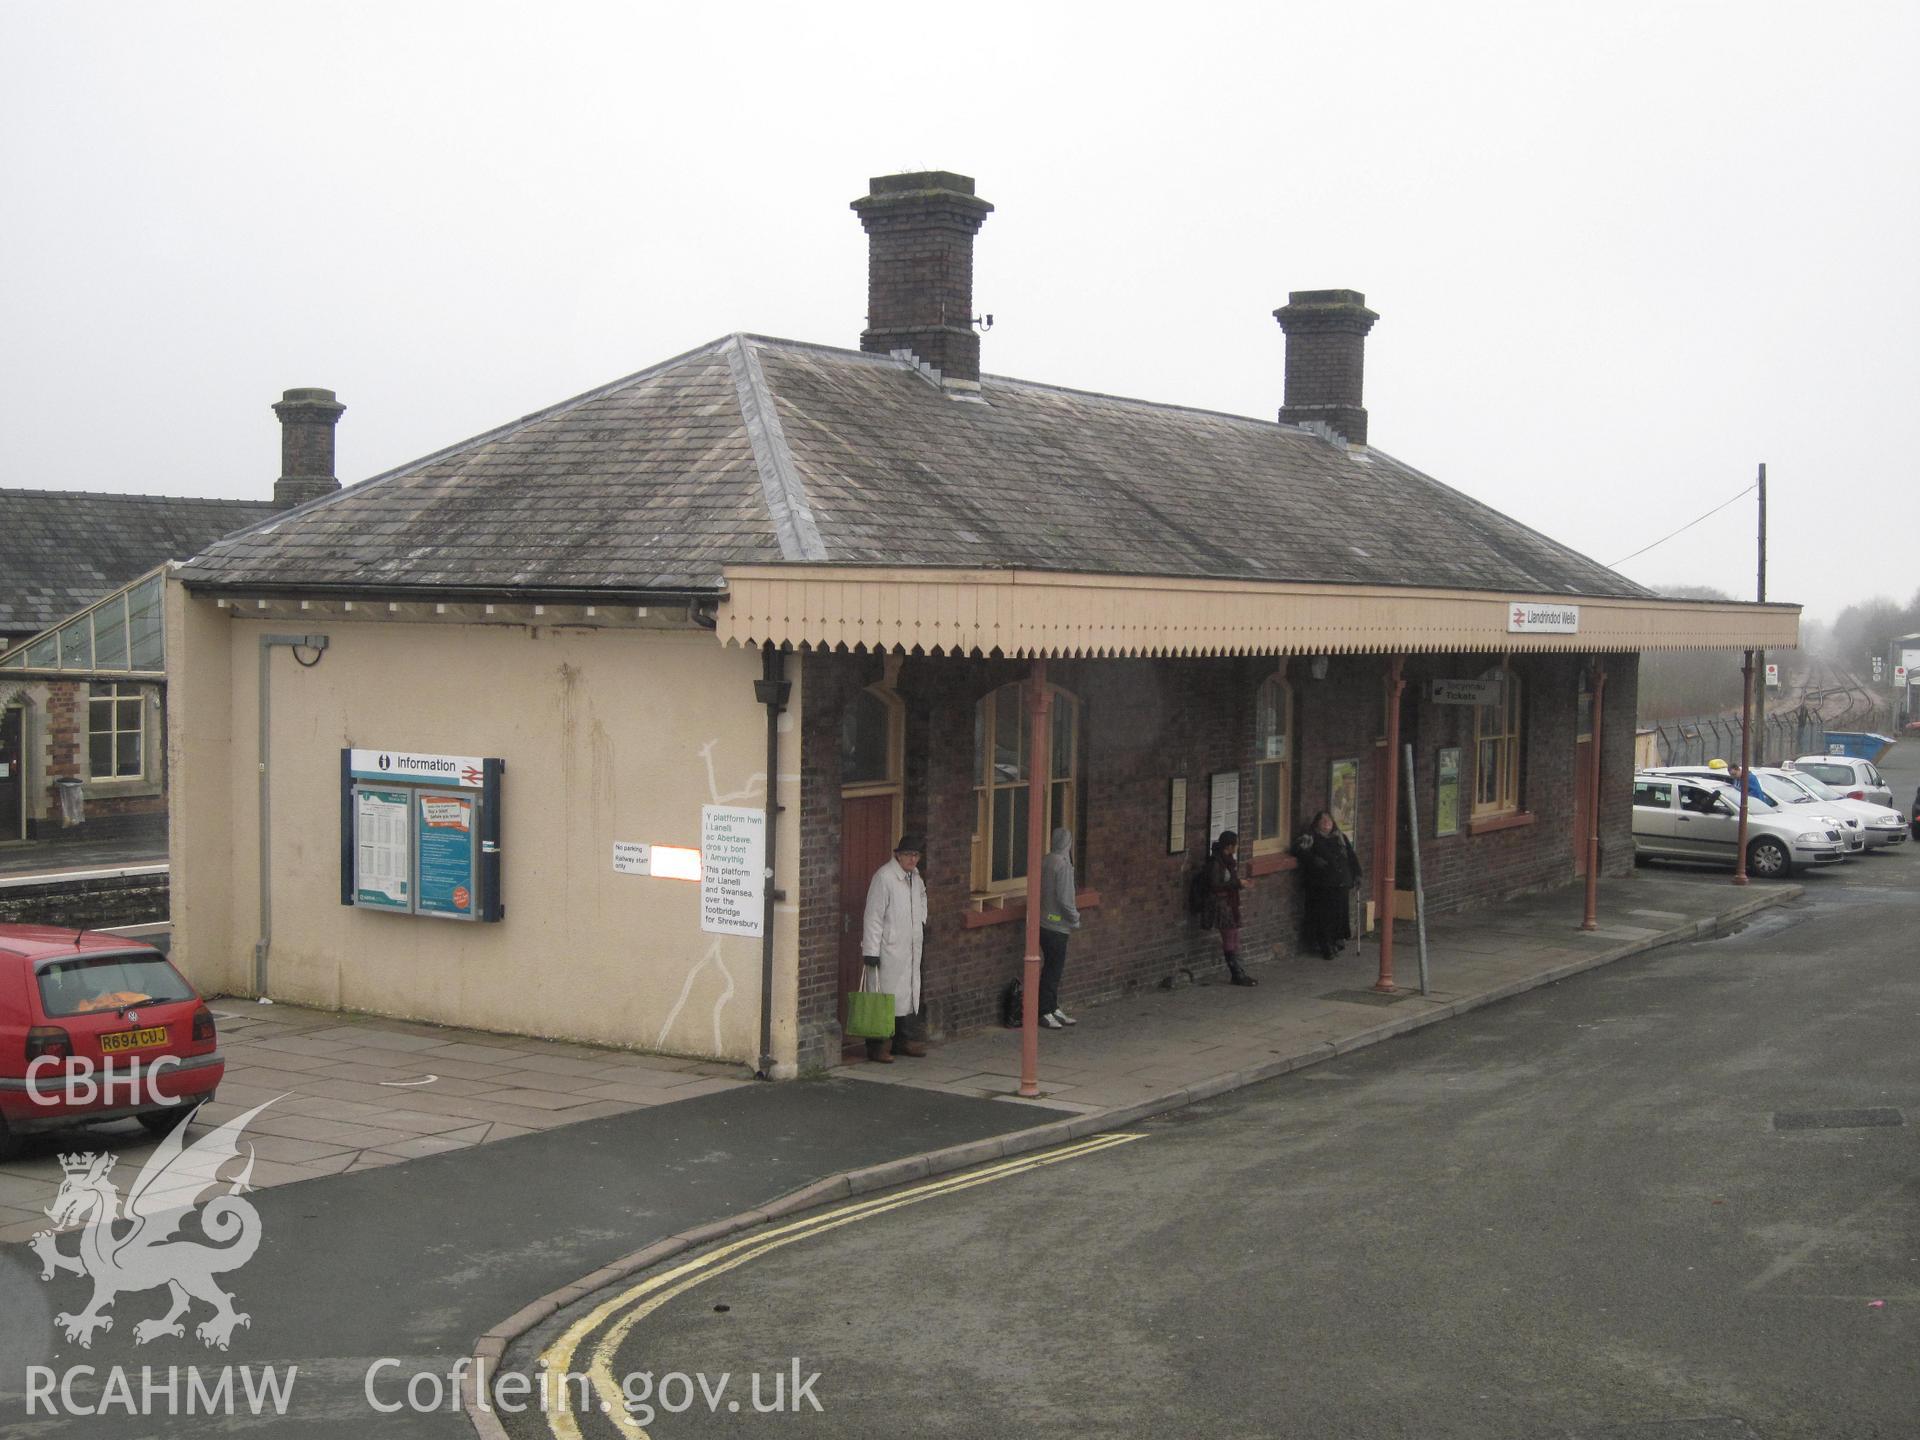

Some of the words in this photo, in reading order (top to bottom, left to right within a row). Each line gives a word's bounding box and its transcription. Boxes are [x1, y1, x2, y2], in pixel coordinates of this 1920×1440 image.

[1527, 610, 1560, 624] Llandrindod
[1561, 612, 1576, 625] Wells
[397, 756, 456, 772] Information
[705, 843, 721, 851] dros
[730, 844, 746, 853] bont
[705, 865, 719, 874] This
[721, 866, 750, 876] platform
[705, 875, 716, 884] for
[717, 876, 741, 886] Llanelli
[705, 886, 718, 894] and
[705, 896, 721, 904] over
[723, 896, 734, 906] the
[705, 905, 741, 918] footbridge
[705, 916, 716, 924] for
[717, 916, 759, 930] Shrewsbury
[102, 1033, 138, 1049] R694
[140, 1029, 166, 1044] CUJ
